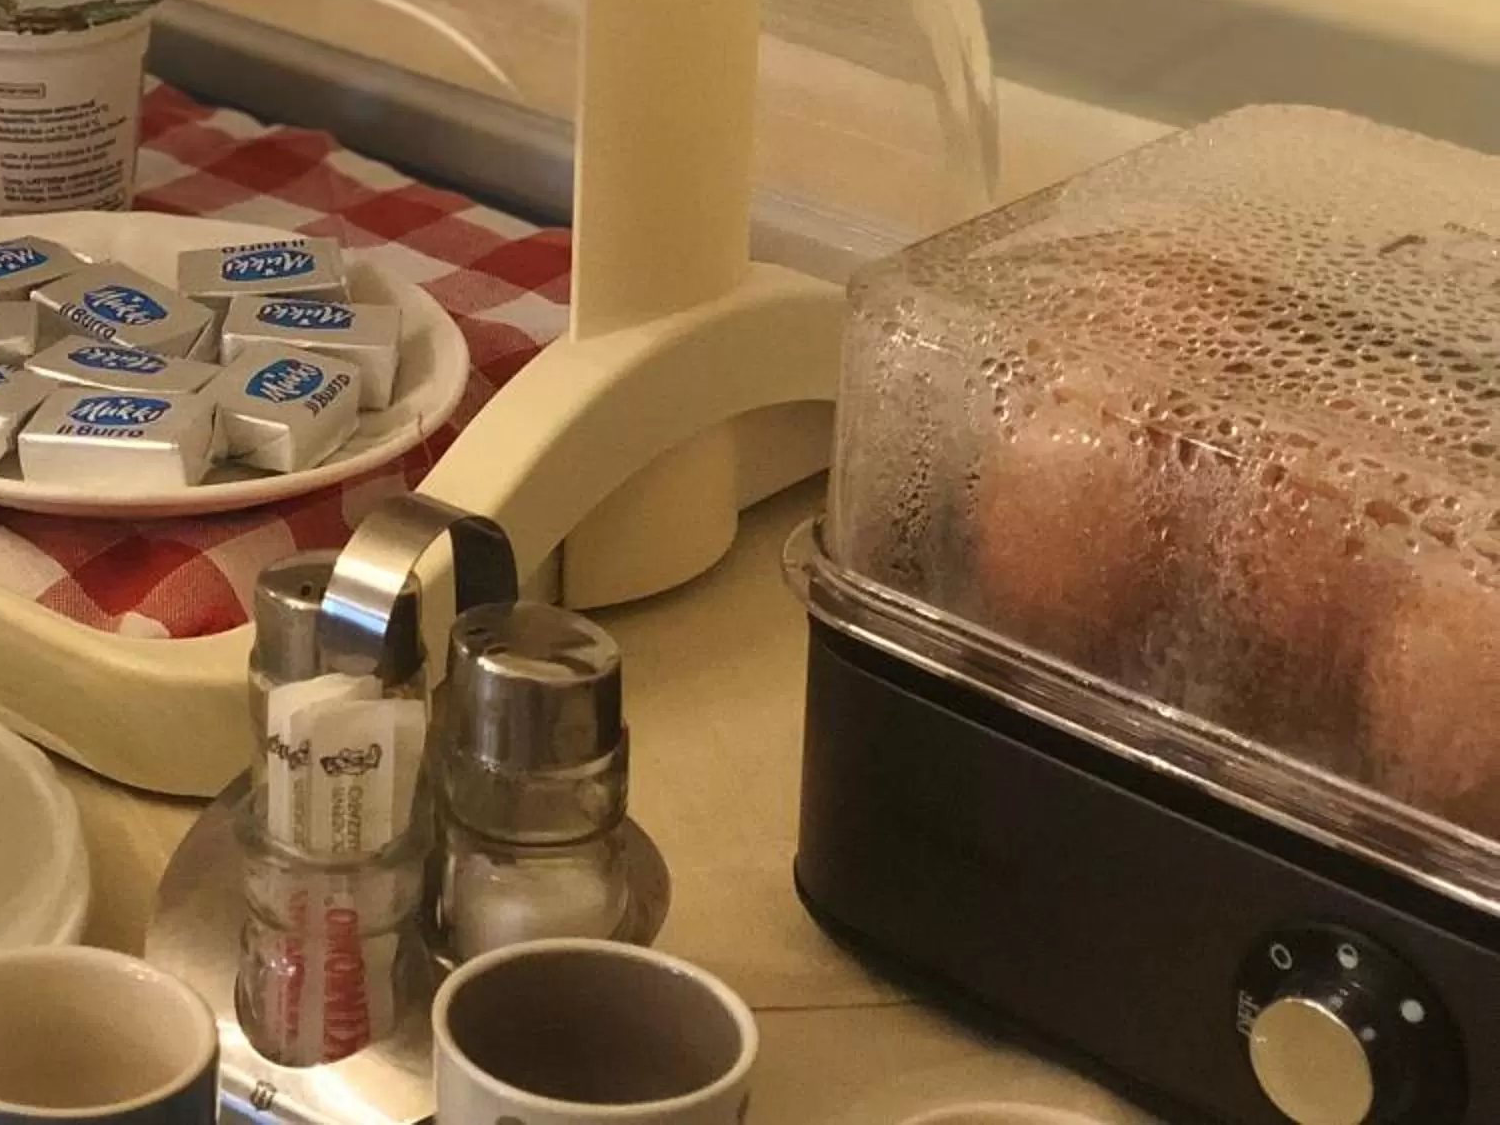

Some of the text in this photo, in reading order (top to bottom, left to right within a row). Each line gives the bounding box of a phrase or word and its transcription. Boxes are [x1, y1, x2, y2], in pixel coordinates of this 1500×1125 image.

[225, 251, 312, 276] Mukki
[70, 307, 117, 340] Burro
[74, 398, 165, 423] Mukki
[75, 425, 145, 438] Burro
